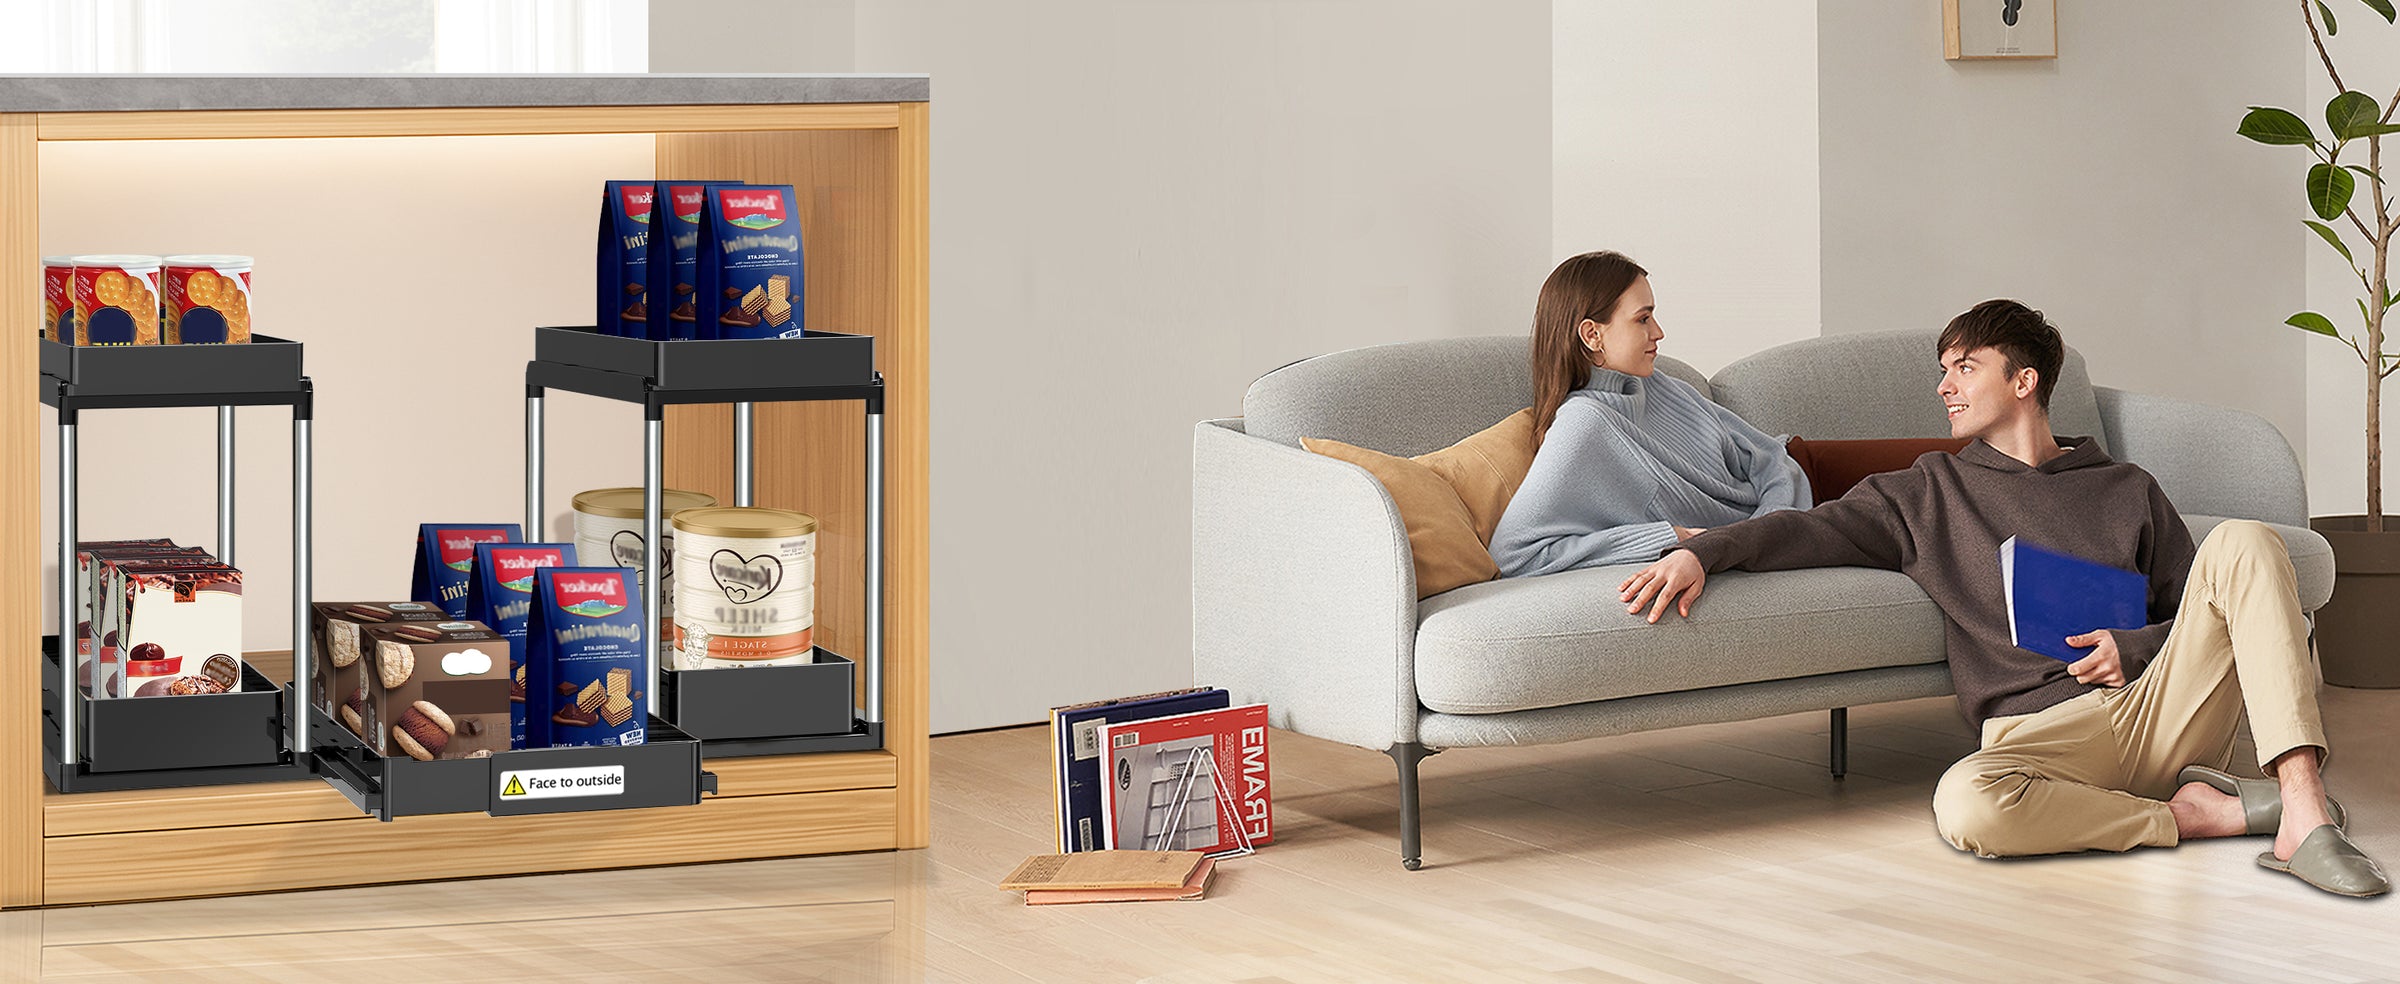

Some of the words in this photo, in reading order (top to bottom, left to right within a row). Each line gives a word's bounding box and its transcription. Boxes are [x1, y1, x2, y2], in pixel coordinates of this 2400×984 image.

[529, 777, 557, 789] Face
[560, 777, 573, 787] to
[576, 773, 622, 787] outside
